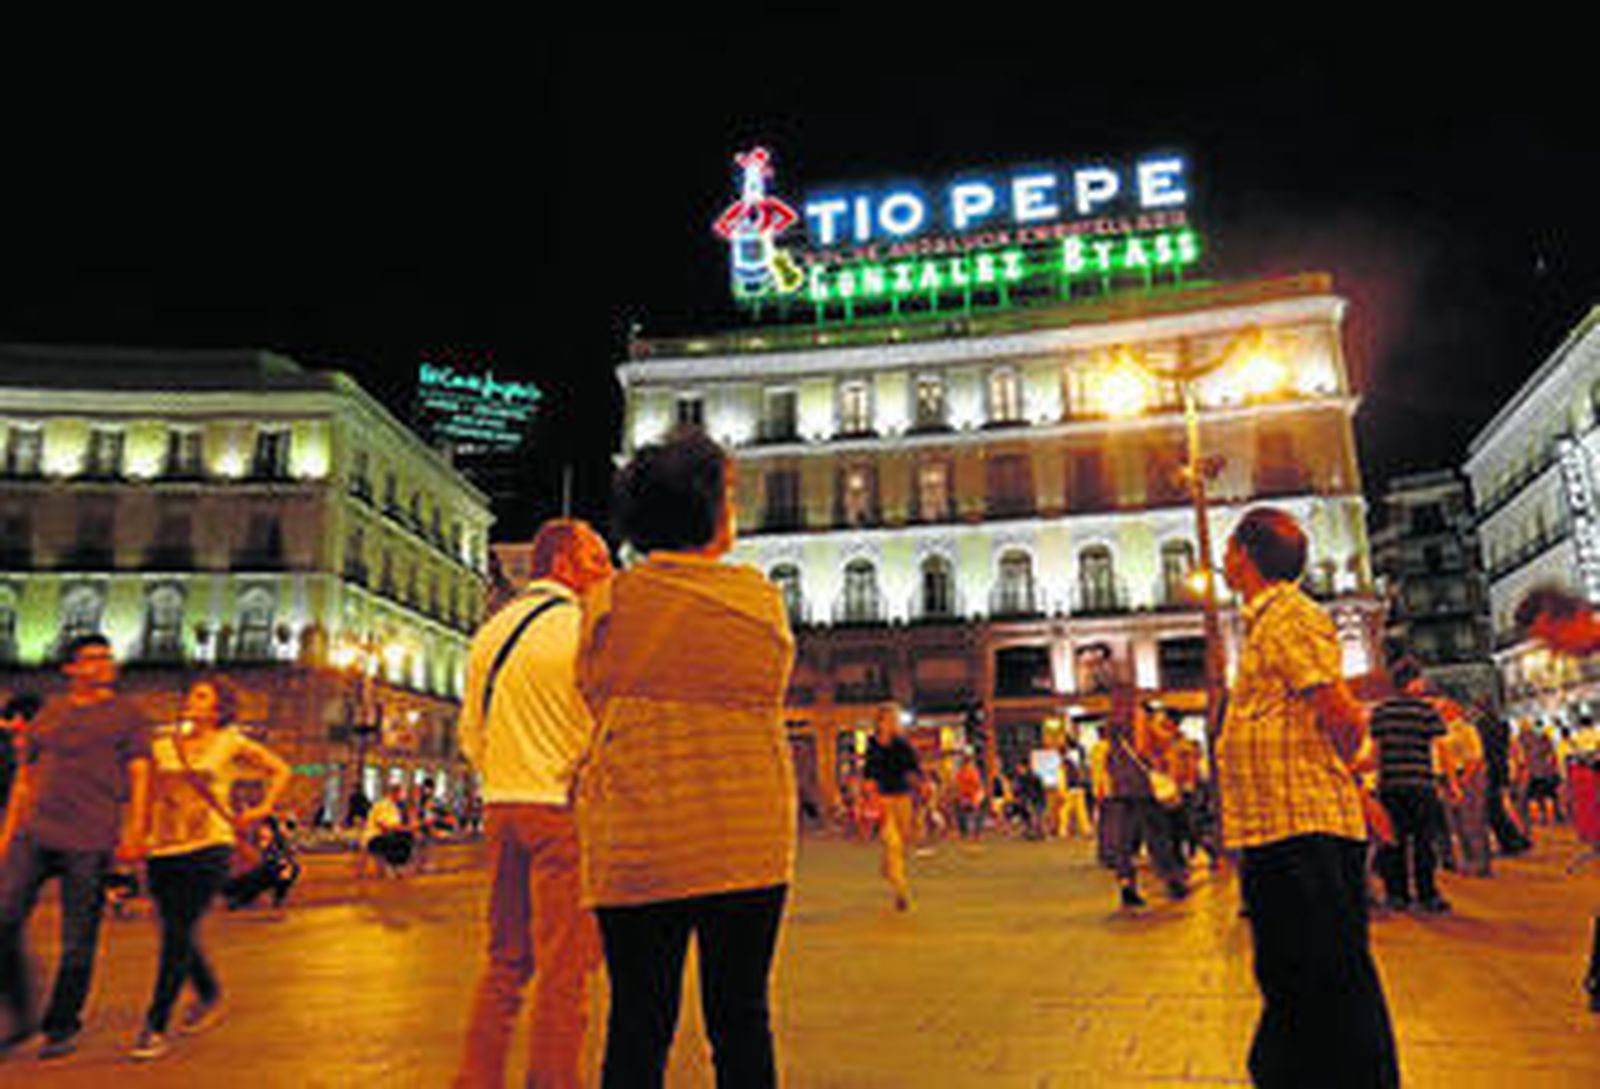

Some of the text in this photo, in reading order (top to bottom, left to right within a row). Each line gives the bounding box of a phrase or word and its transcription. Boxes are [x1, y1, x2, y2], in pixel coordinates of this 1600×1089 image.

[805, 159, 1186, 245] TIO PEPE
[809, 251, 1023, 299] GONZALEZ
